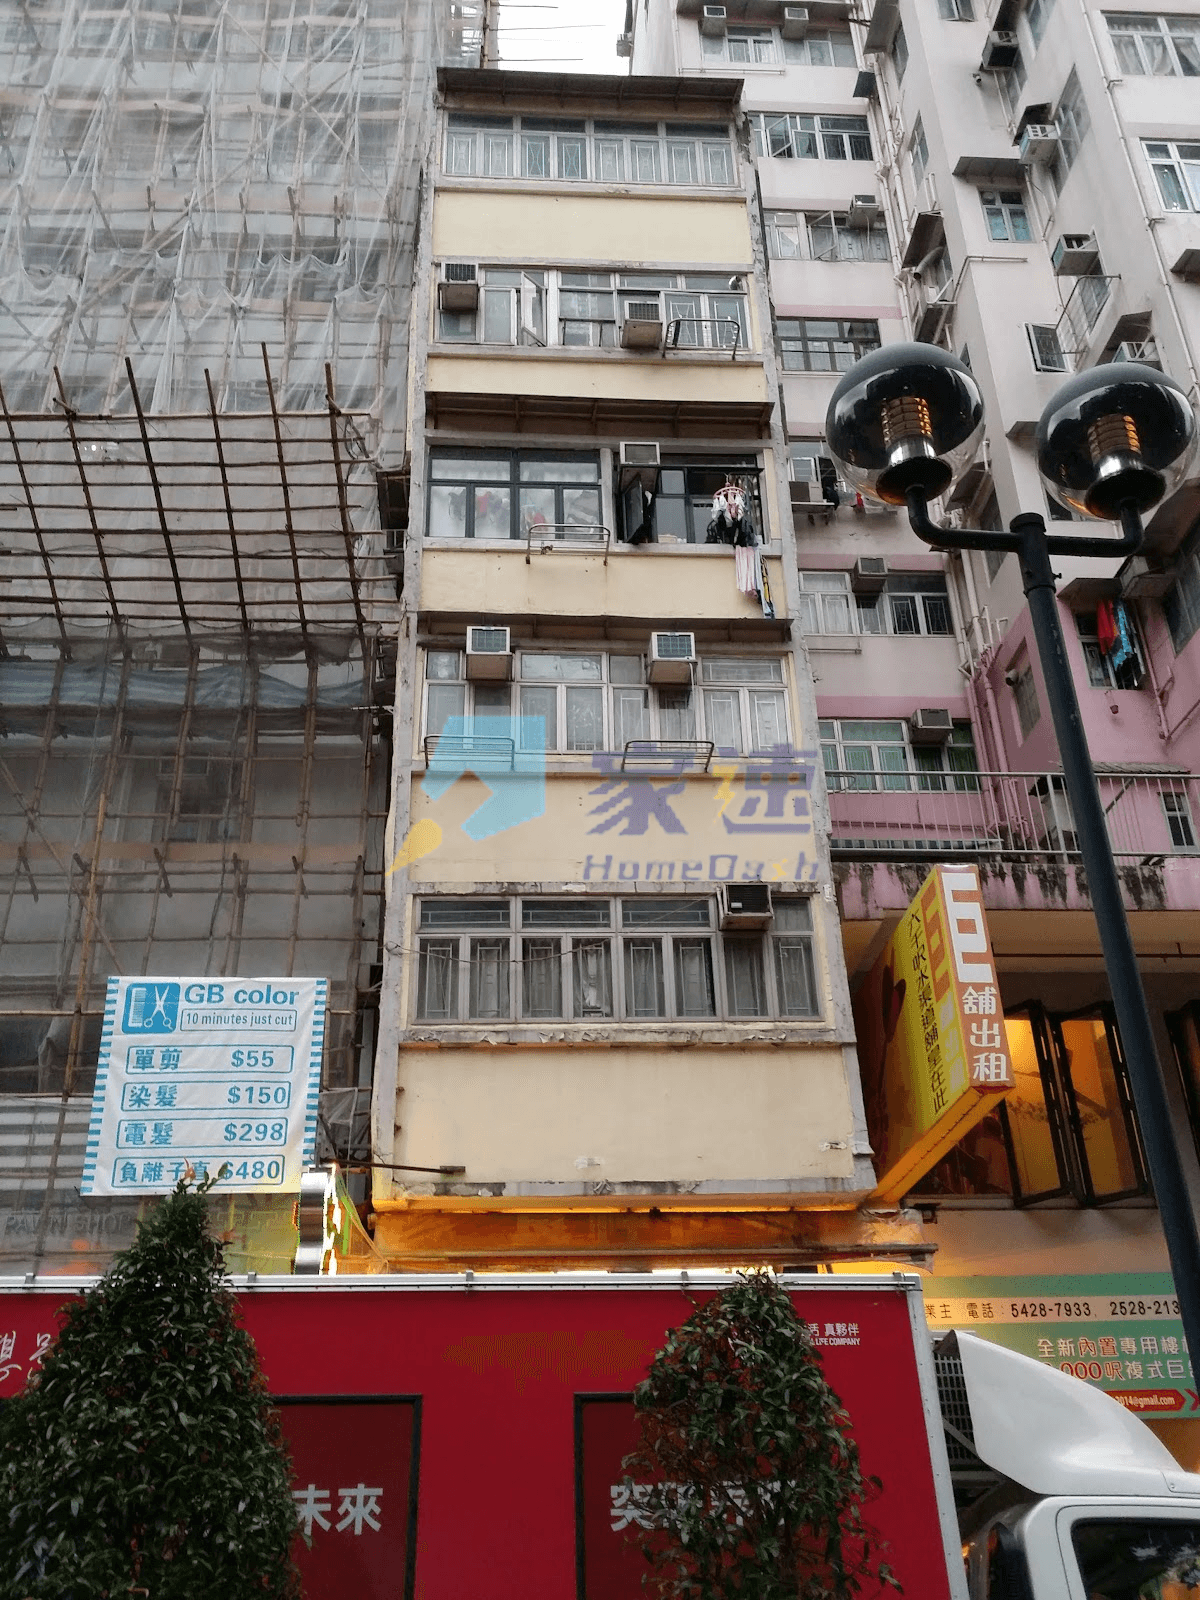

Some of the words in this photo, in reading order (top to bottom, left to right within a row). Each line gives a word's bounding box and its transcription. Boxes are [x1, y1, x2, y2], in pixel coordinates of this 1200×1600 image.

[184, 983, 225, 1004] GB
[234, 984, 299, 1006] color
[186, 1013, 198, 1025] 10
[201, 1013, 248, 1025] minutes
[250, 1013, 272, 1027] just
[276, 1013, 293, 1025] cut
[132, 1049, 183, 1071] 單剪
[231, 1049, 274, 1068] $55
[128, 1084, 178, 1107] 染髮
[227, 1086, 287, 1105] $150
[124, 1122, 173, 1145] 電髮
[224, 1123, 283, 1142] $298
[223, 1161, 280, 1181] $480
[815, 1338, 828, 1346] LIFE
[829, 1338, 860, 1346] COMPANY
[1044, 1360, 1194, 1381] 000呎複式巨
[292, 1483, 383, 1536] 未來
